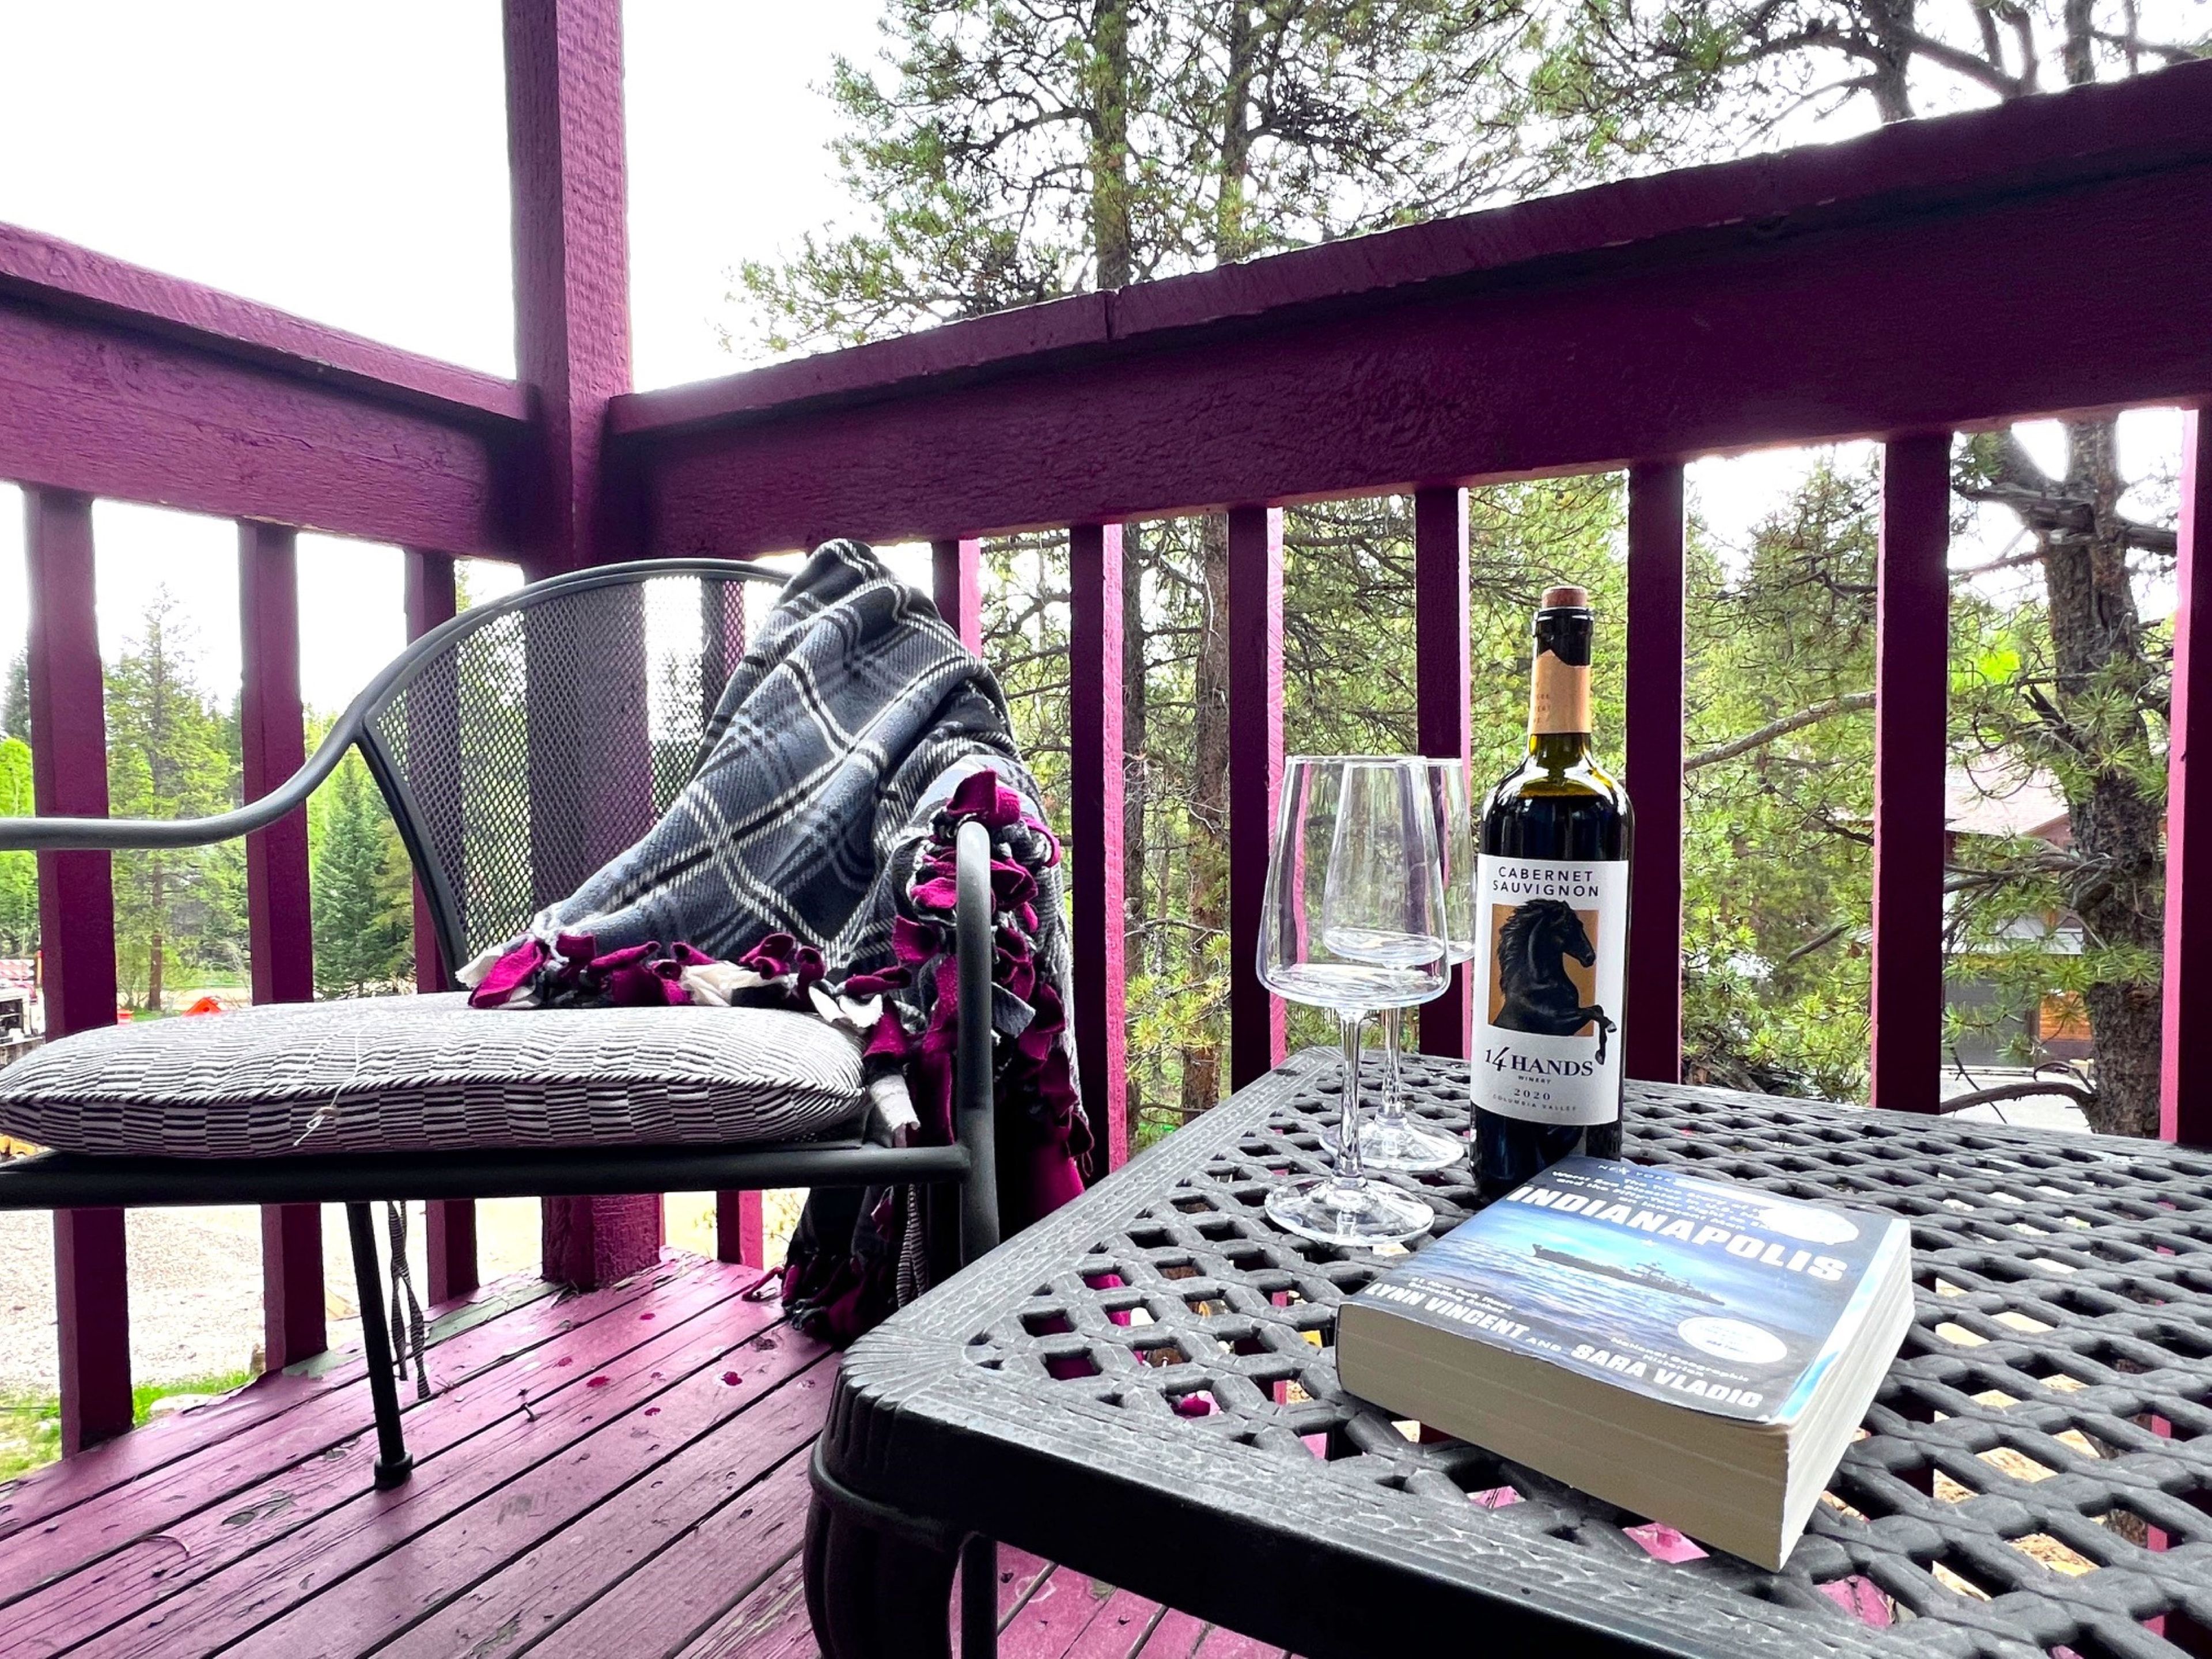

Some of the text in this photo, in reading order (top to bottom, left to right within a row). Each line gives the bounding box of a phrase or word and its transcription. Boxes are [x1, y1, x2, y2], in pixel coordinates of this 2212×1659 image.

[1498, 866, 1593, 881] CABERNET
[1493, 880, 1599, 897] SAUVIGNON
[1485, 1047, 1593, 1076] 14 HANDS
[1518, 1075, 1551, 1084] WINERY
[1493, 1094, 1537, 1108] COLUMBIA
[1513, 1088, 1551, 1101] 2020
[1506, 1186, 1848, 1282] INDIANAPOLIS
[1364, 1283, 1763, 1408] LYNN VINCENT AND SARA VLADIC
